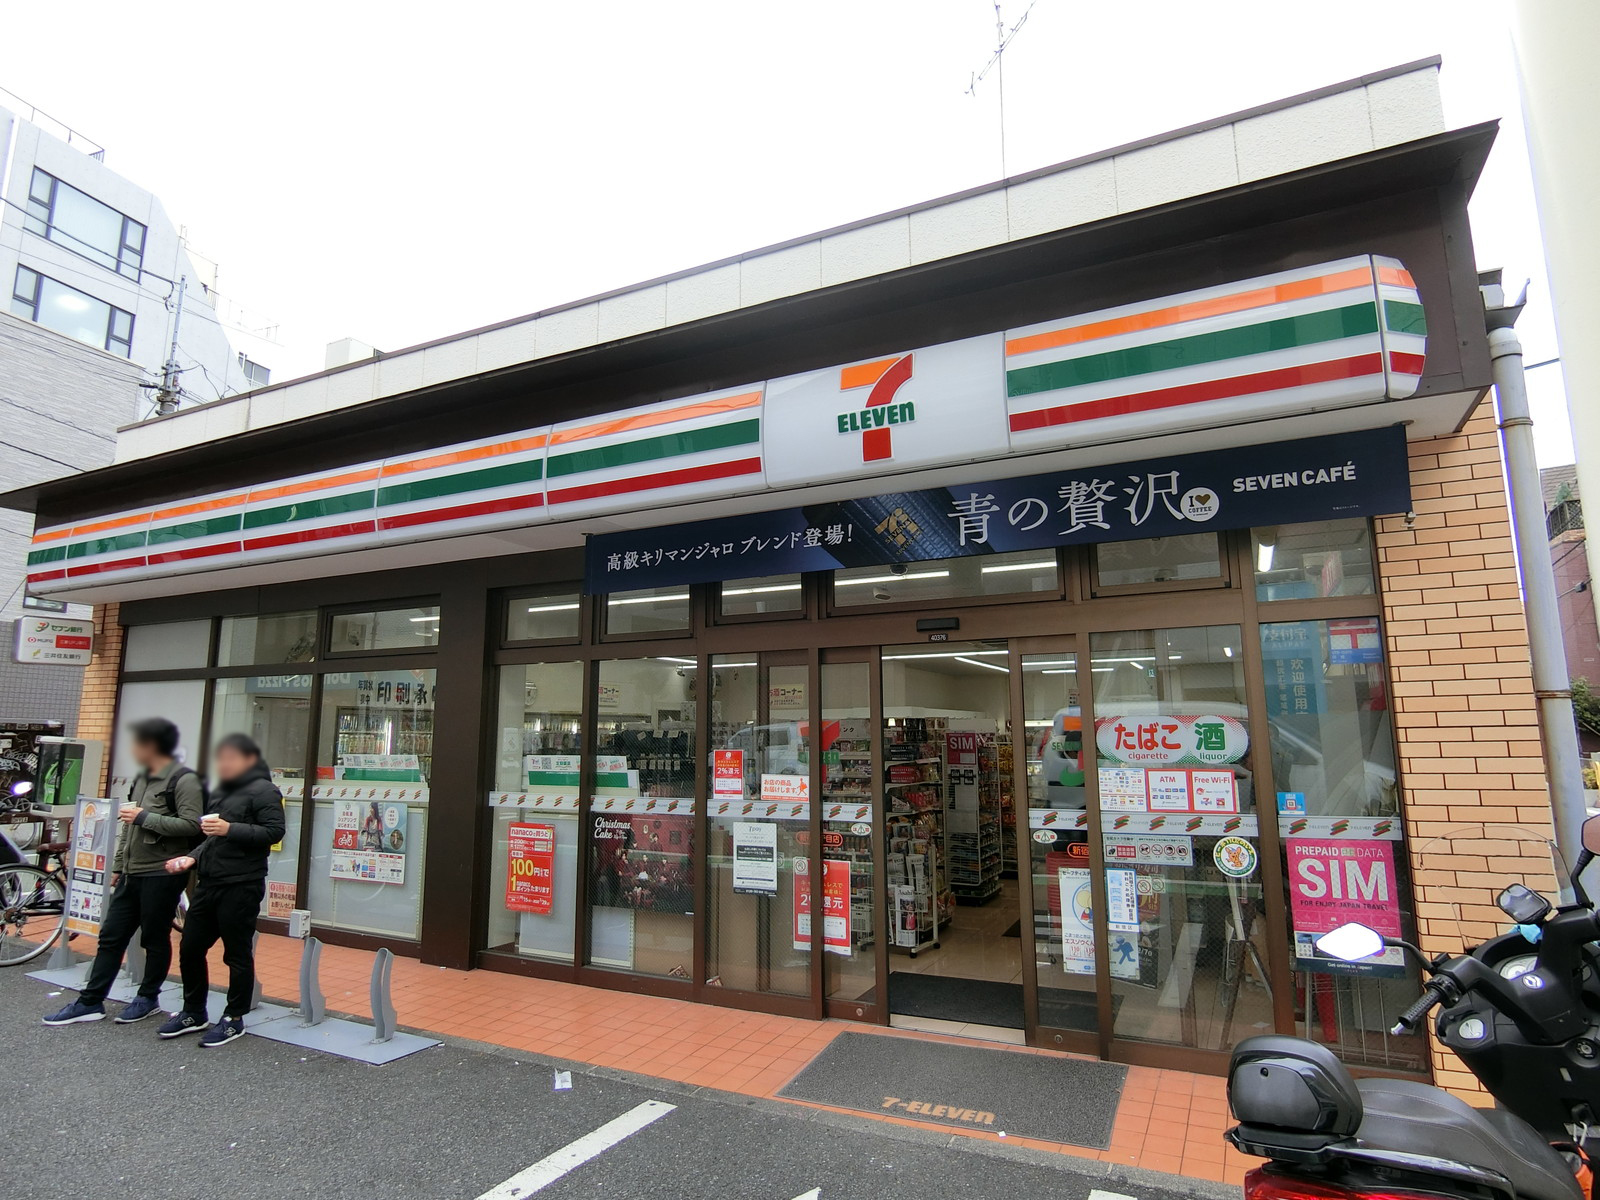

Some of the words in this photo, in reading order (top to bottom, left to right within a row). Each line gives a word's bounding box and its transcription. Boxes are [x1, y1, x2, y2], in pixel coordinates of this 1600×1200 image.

[1233, 471, 1297, 492] SEVEN
[1301, 462, 1357, 485] CAFÉ
[947, 470, 1184, 547] 青の贅沢
[606, 542, 734, 573] 高級キリマンジャロ
[1114, 722, 1181, 750] たばこ
[1194, 722, 1226, 750] 酒
[949, 737, 974, 750] SIM
[1128, 752, 1168, 760] cigarette
[1199, 752, 1227, 760] liquor
[1211, 776, 1231, 784] Wi-Fi
[594, 816, 631, 830] Christmas
[594, 827, 613, 839] Cake
[1295, 846, 1338, 857] PREPAID
[1357, 848, 1384, 857] DATA
[1297, 858, 1389, 902] SIM
[1363, 903, 1389, 911] TRAVEL
[881, 1096, 996, 1125] 7-ELEVEN
